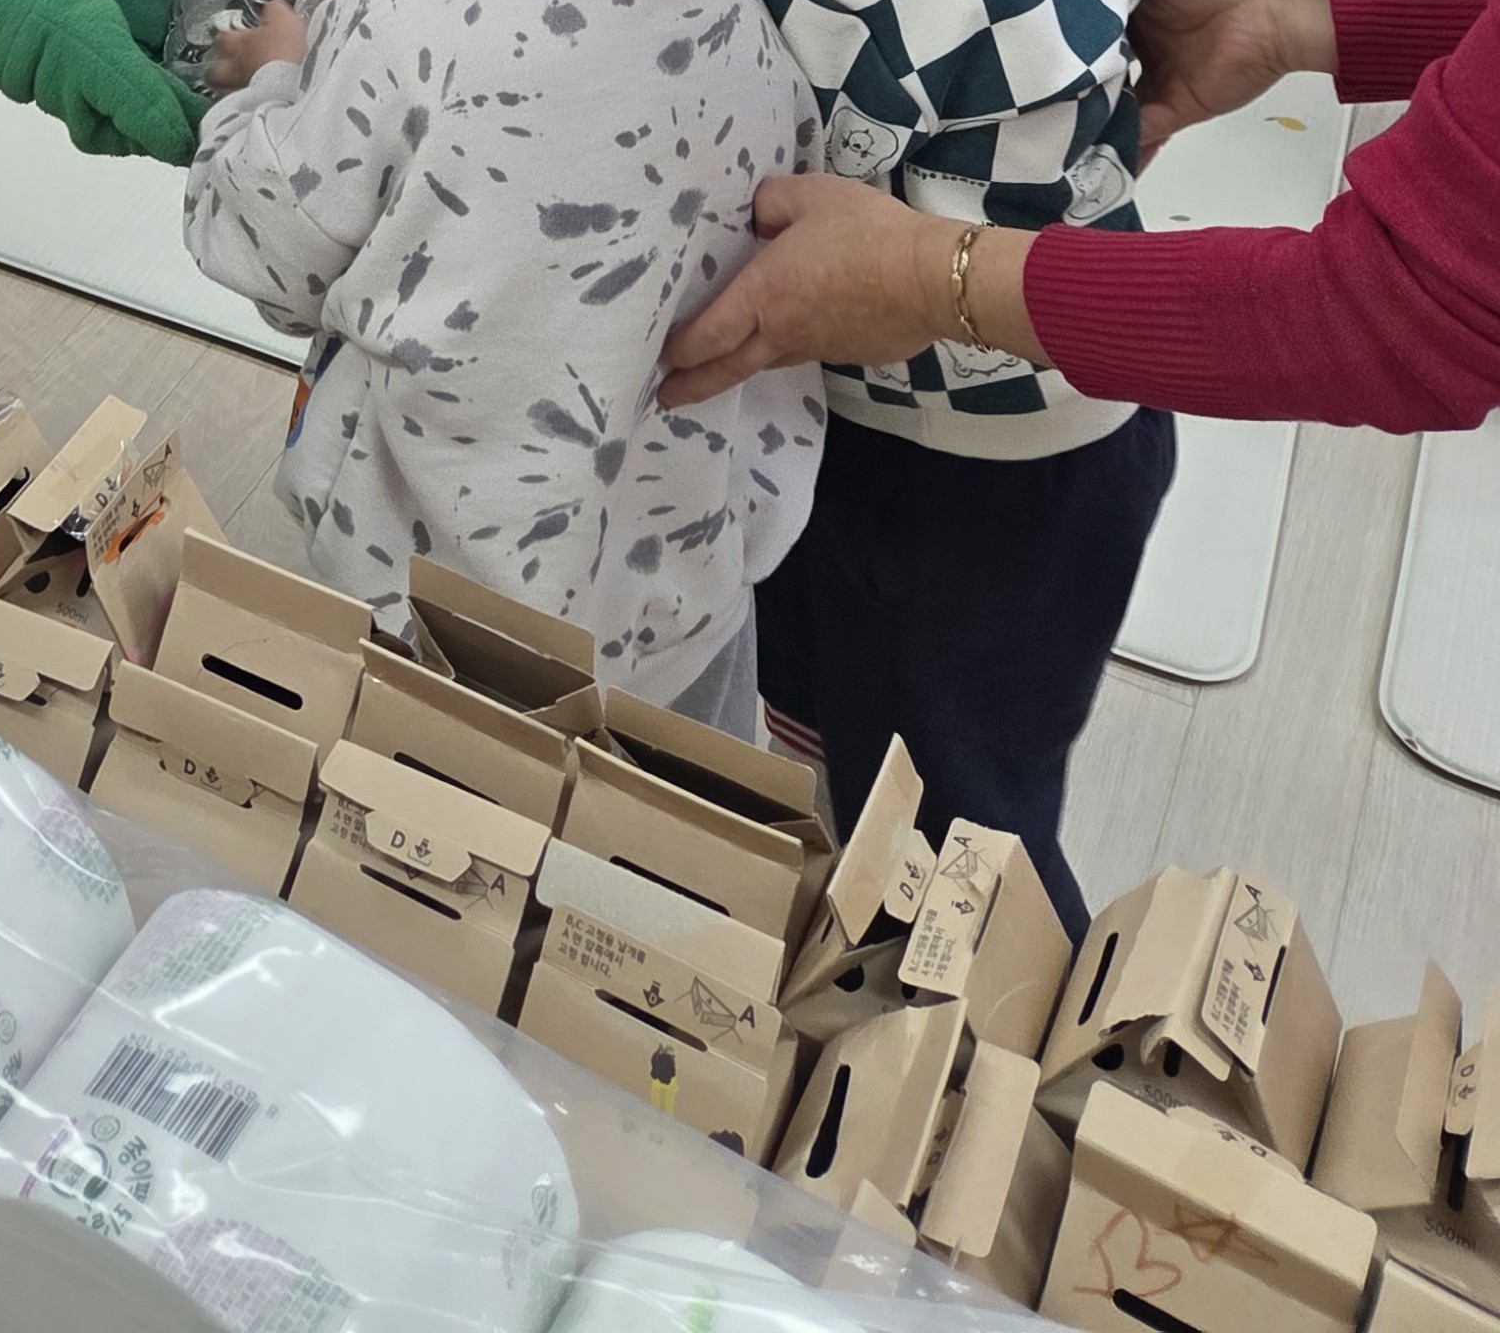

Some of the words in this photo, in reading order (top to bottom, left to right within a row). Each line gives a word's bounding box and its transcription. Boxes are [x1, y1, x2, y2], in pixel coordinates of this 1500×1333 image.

[55, 601, 89, 626] 500ml
[184, 759, 197, 775] D
[390, 829, 406, 849] D
[953, 836, 972, 848] A
[490, 873, 505, 896] A
[899, 882, 914, 901] D
[1245, 884, 1262, 904] A
[739, 1004, 756, 1029] A
